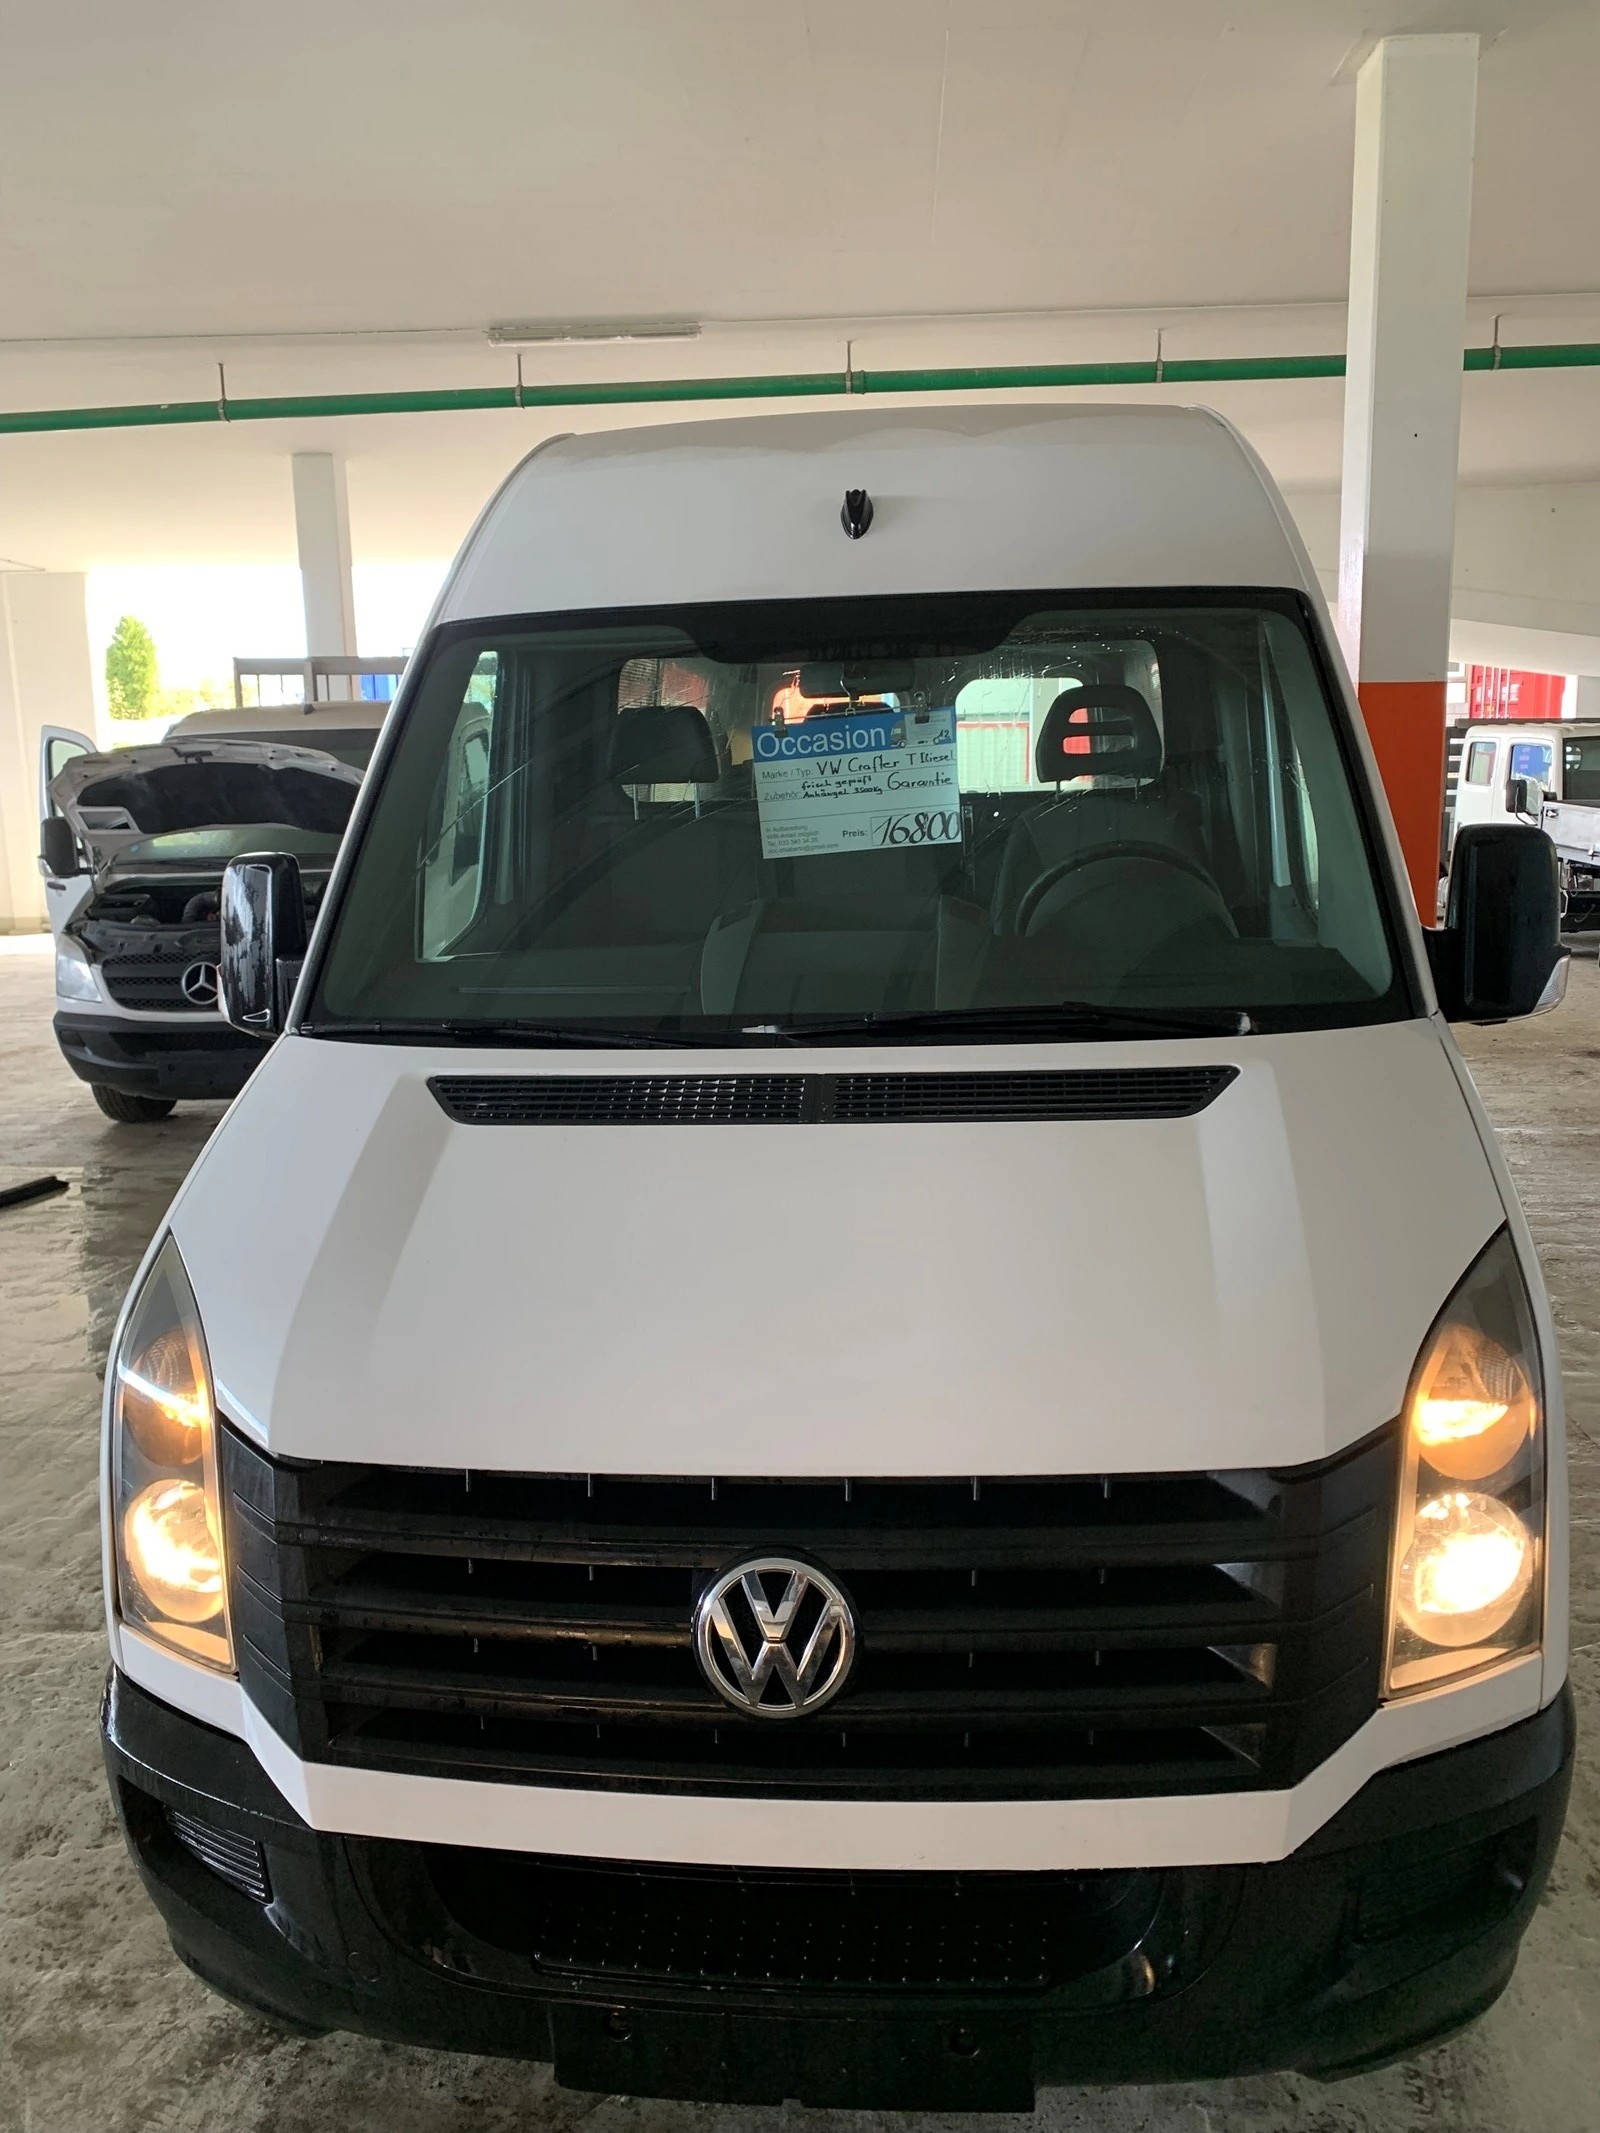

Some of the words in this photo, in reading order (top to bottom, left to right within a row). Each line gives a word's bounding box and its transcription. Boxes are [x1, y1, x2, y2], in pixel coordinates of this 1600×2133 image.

[757, 725, 886, 758] Occasion
[762, 769, 788, 780] Marke
[817, 758, 842, 776] VW
[847, 754, 900, 774] Crafter
[887, 771, 953, 791] Garantie
[842, 828, 869, 838] Preis:
[873, 811, 961, 846] 16800
[704, 1566, 848, 1711] VW
